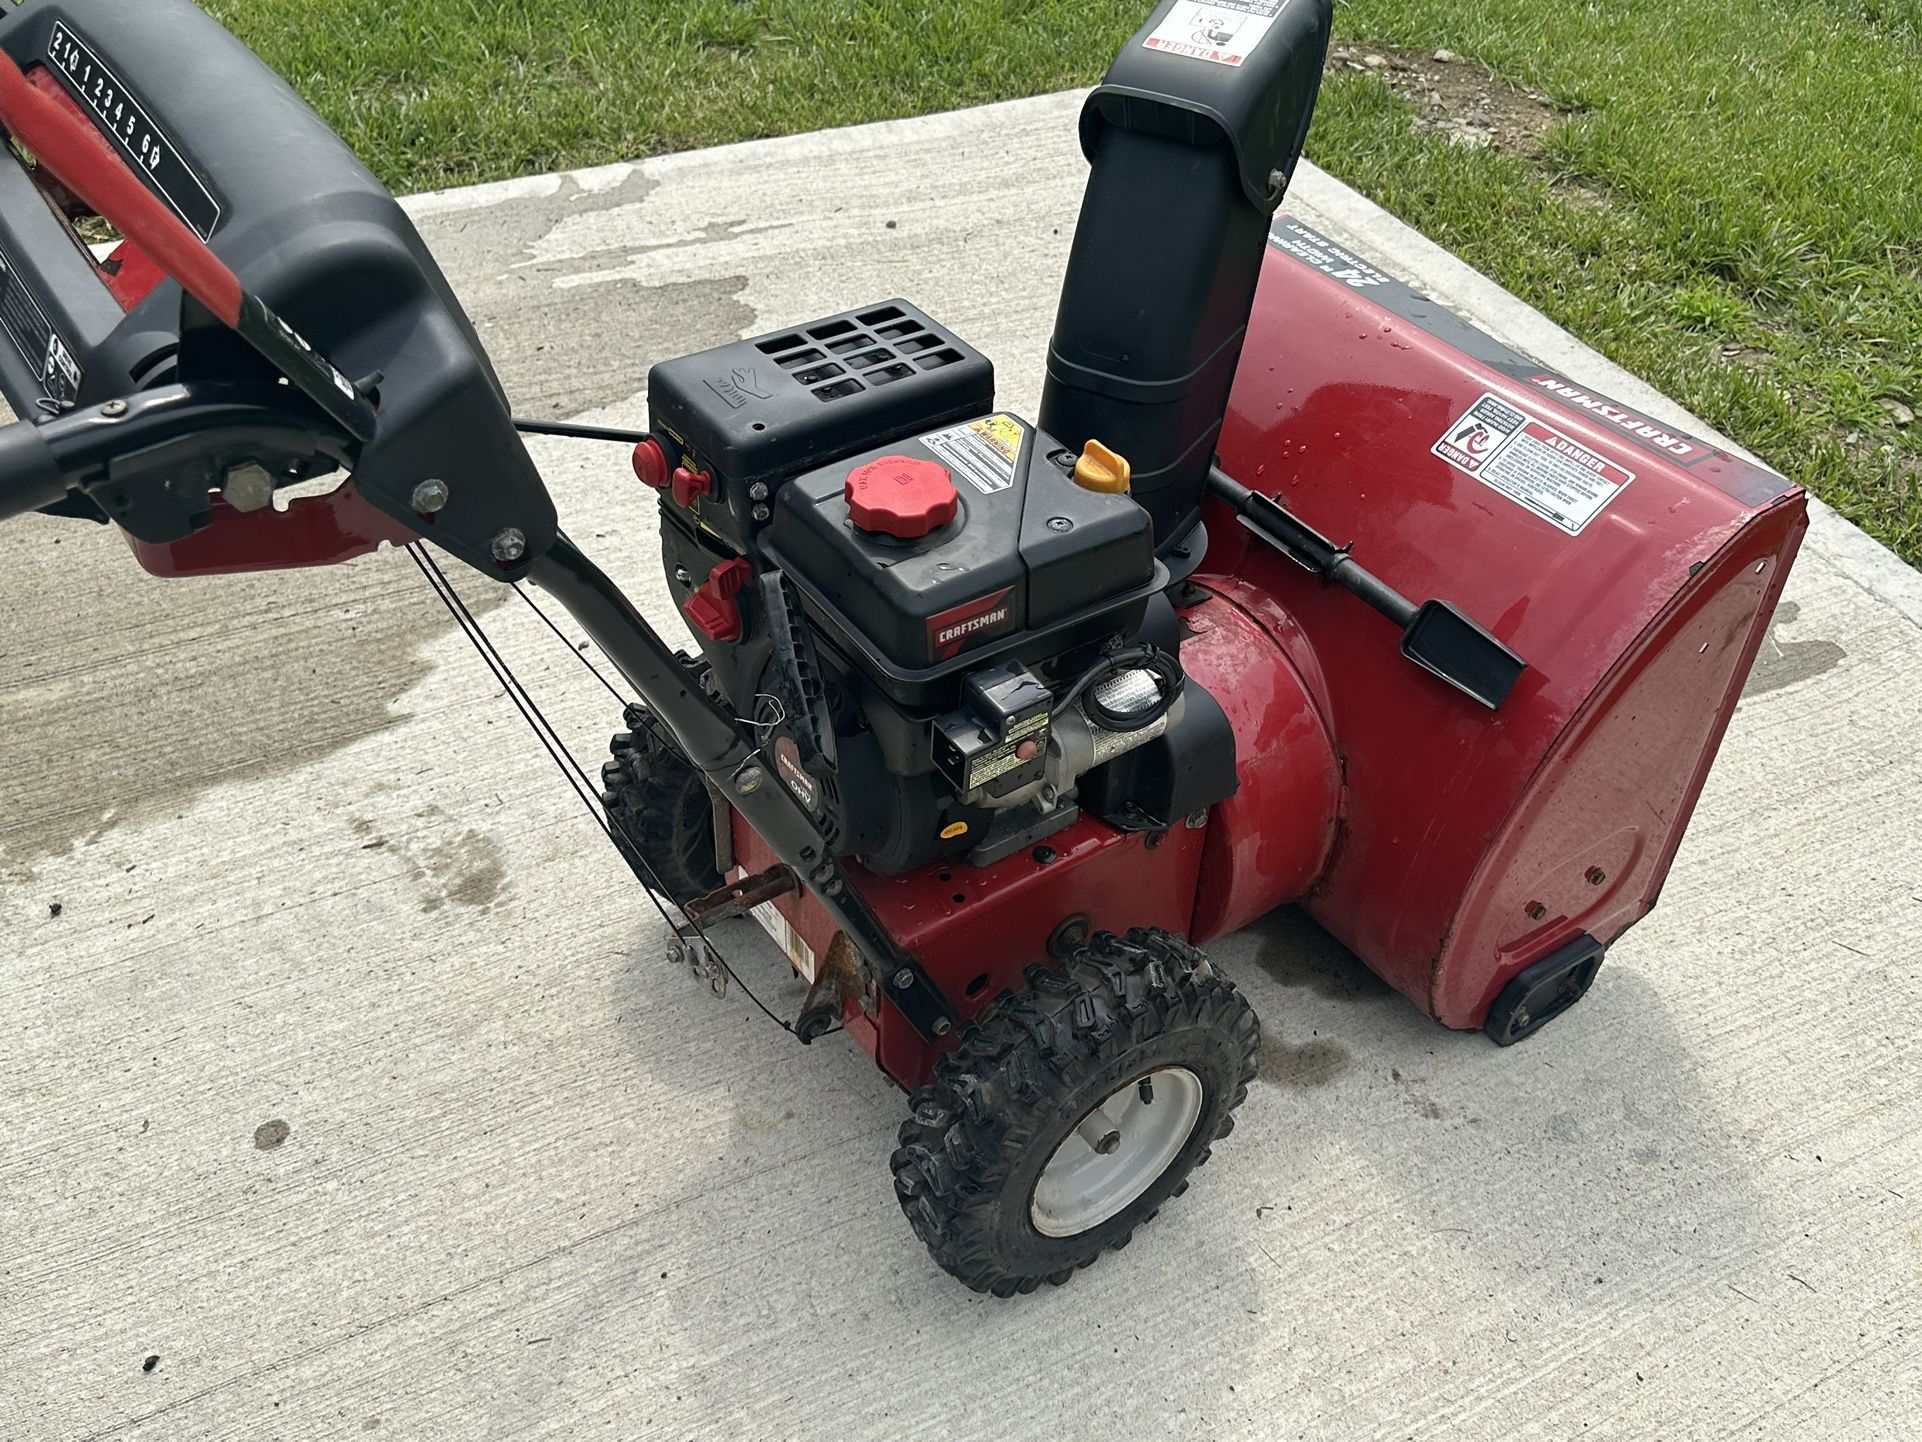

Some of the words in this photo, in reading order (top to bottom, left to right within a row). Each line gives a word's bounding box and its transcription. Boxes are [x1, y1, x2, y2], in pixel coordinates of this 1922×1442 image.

[1158, 39, 1212, 58] DANGER
[54, 32, 63, 50] 2
[64, 42, 71, 58] 1
[84, 65, 91, 81] 1
[95, 78, 104, 97] 2
[105, 89, 113, 107] 3
[115, 103, 124, 120] 4
[127, 116, 136, 134] 5
[142, 134, 150, 153] 6
[1286, 224, 1329, 247] START
[1291, 240, 1334, 263] WIDTH
[1327, 247, 1390, 282] ELECTRIC
[1537, 378, 1693, 455] CRAFTSMAN
[981, 430, 1011, 454] WARNING
[1438, 442, 1469, 465] DANGER
[1555, 439, 1607, 472] DANGER
[939, 608, 1005, 643] CRAFTSMAN
[781, 753, 812, 791] CRAFTSMAN
[791, 780, 811, 803] OHV
